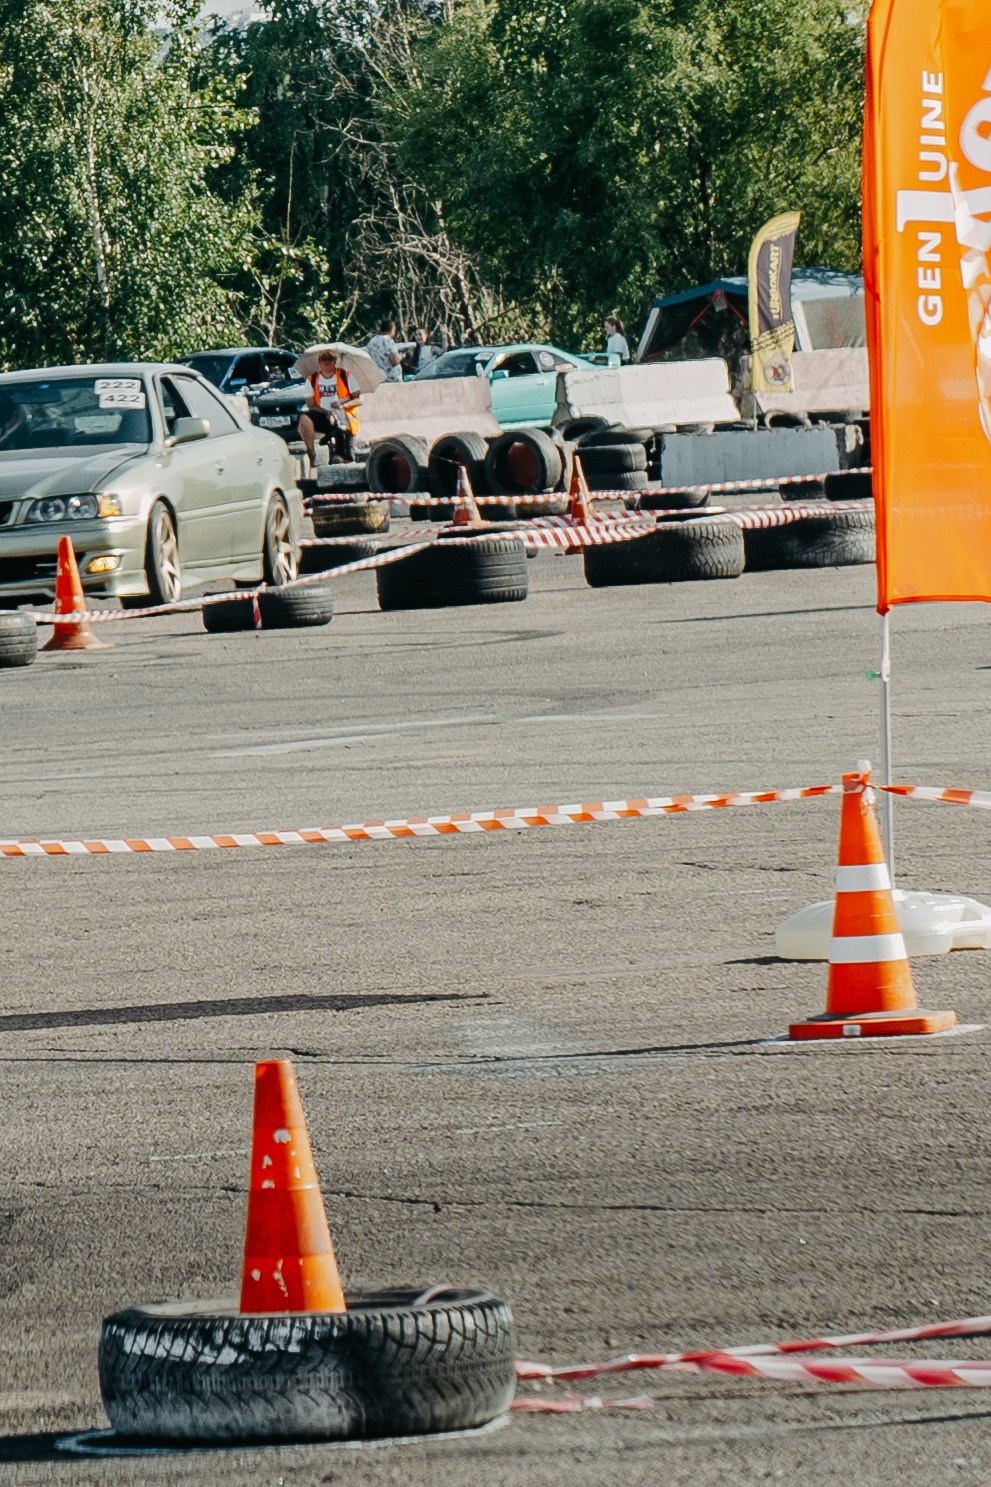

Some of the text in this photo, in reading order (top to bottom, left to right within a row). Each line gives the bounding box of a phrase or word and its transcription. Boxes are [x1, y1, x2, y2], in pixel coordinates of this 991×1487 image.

[769, 243, 781, 320] TURBOKART
[100, 381, 136, 390] 222
[104, 394, 140, 403] 422
